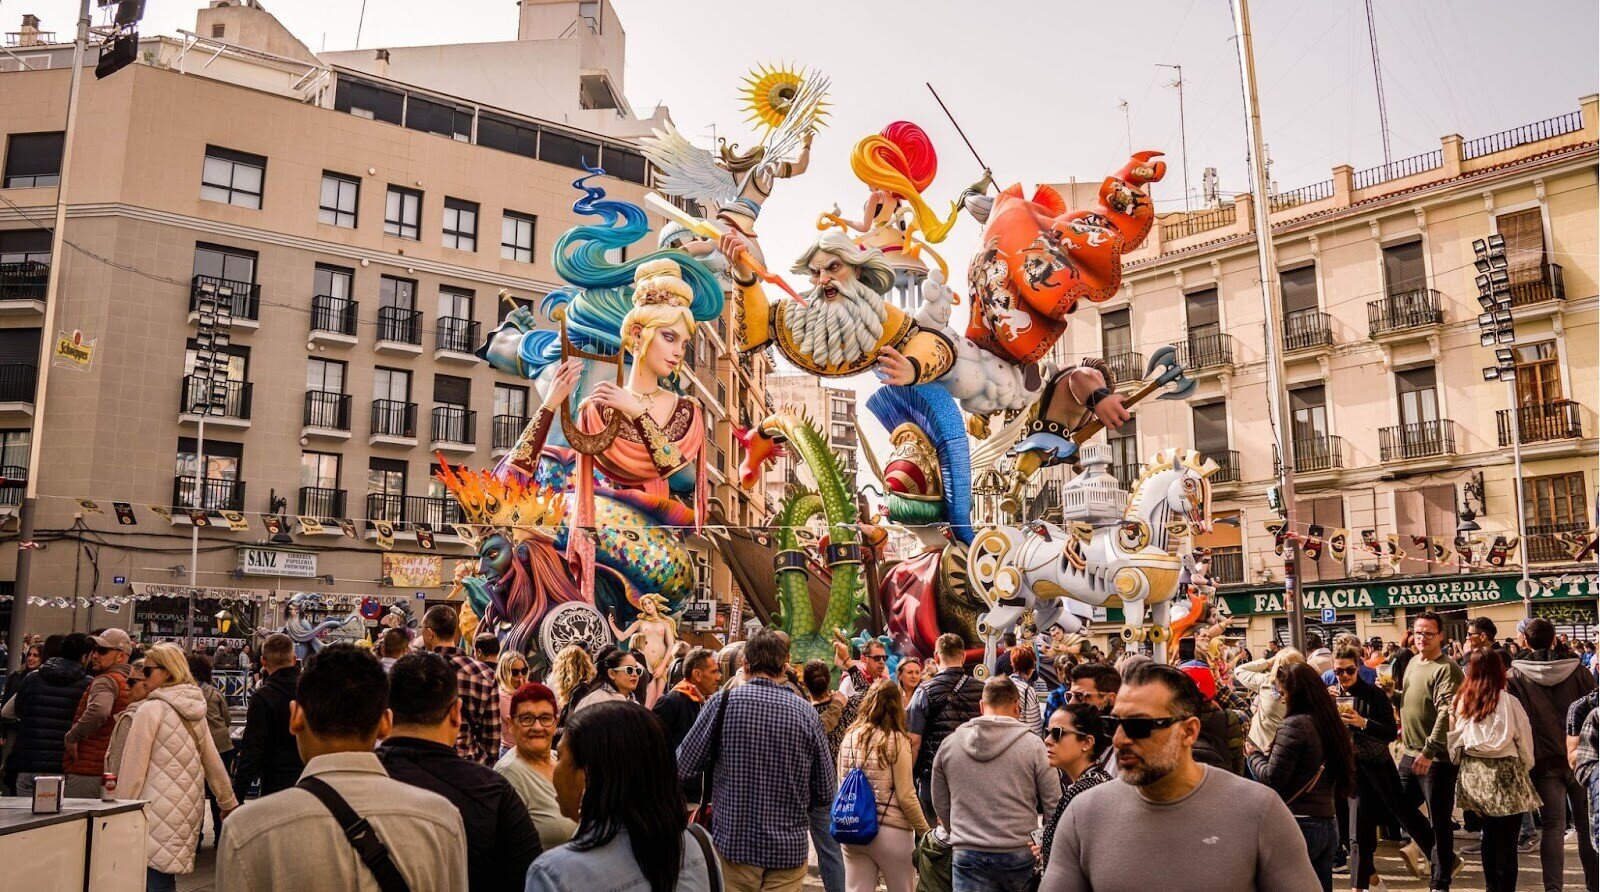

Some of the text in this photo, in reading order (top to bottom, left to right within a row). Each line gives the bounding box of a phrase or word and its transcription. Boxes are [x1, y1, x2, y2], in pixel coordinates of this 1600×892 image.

[248, 550, 277, 568] SANZ
[145, 585, 192, 597] CONSUMIBLE
[1387, 580, 1500, 596] ORTOPEDIA
[1254, 587, 1374, 612] FAMACIA
[1388, 590, 1500, 606] LABORATORIO
